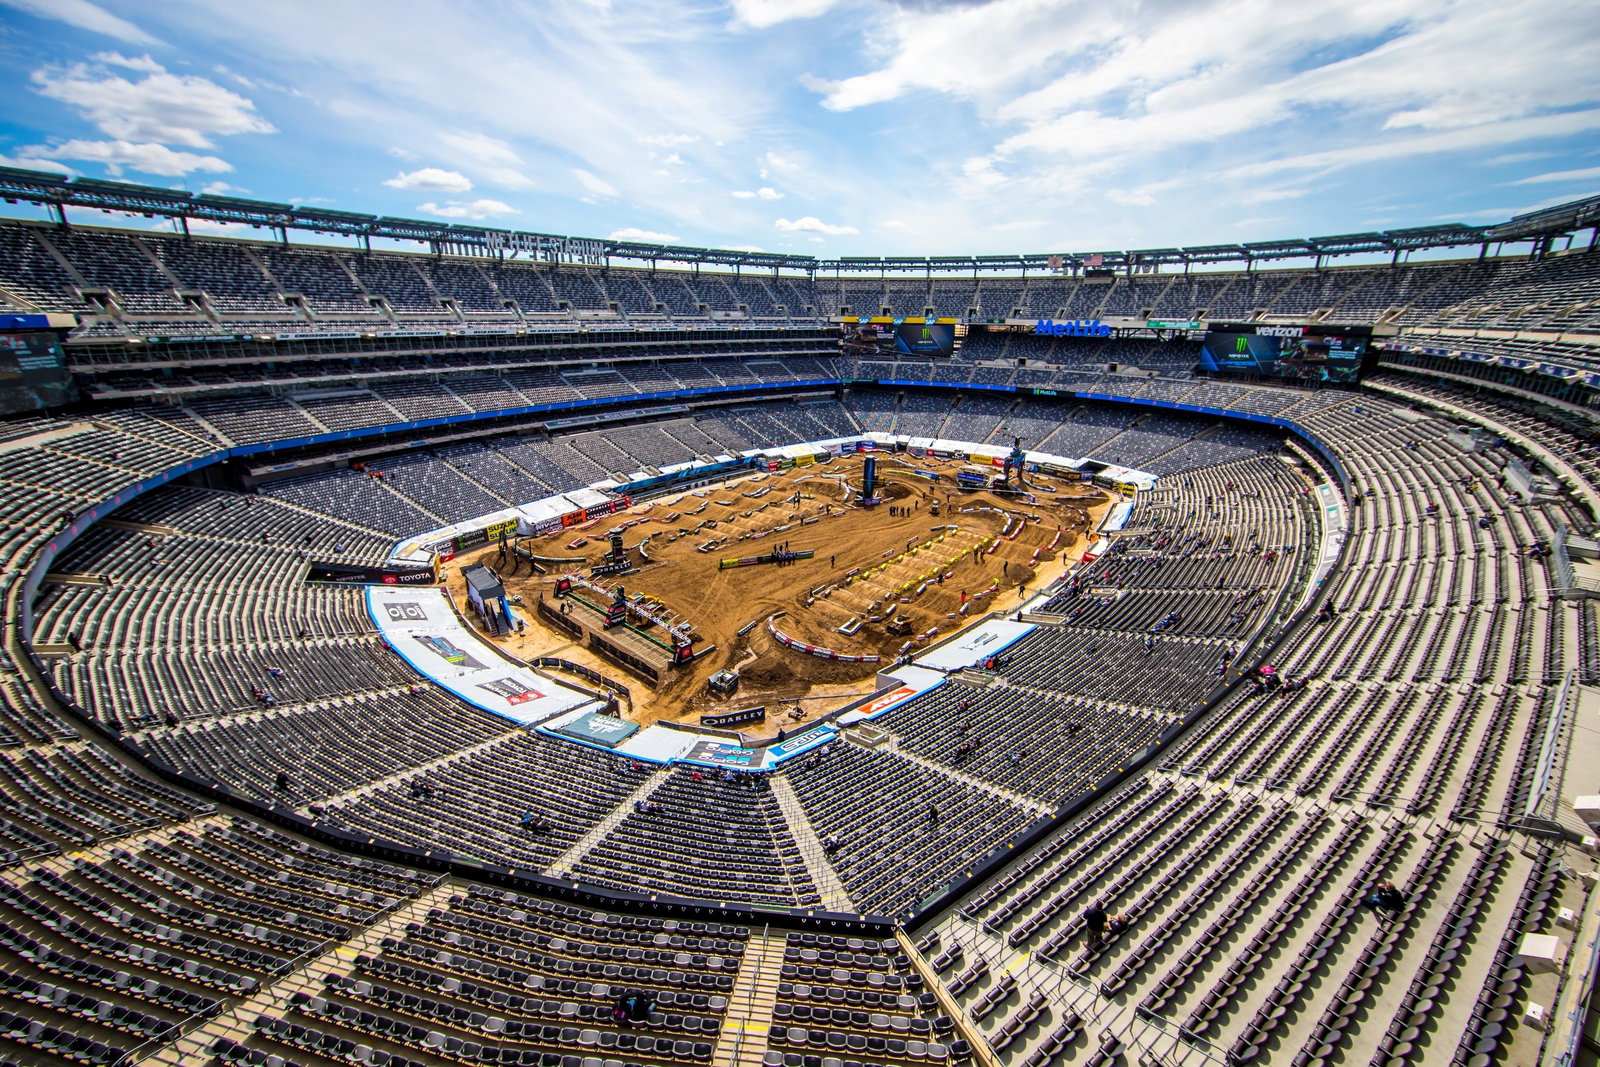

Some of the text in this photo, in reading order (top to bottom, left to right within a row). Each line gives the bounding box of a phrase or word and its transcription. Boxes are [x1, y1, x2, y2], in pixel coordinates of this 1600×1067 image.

[485, 231, 604, 257] METLIFE STADIUM
[1035, 319, 1111, 337] MetLife
[1255, 326, 1303, 337] verizon
[399, 573, 431, 582] TOYOTA
[719, 711, 764, 725] OAKLEY
[705, 746, 753, 756] GoPro
[699, 756, 750, 766] GoPro
